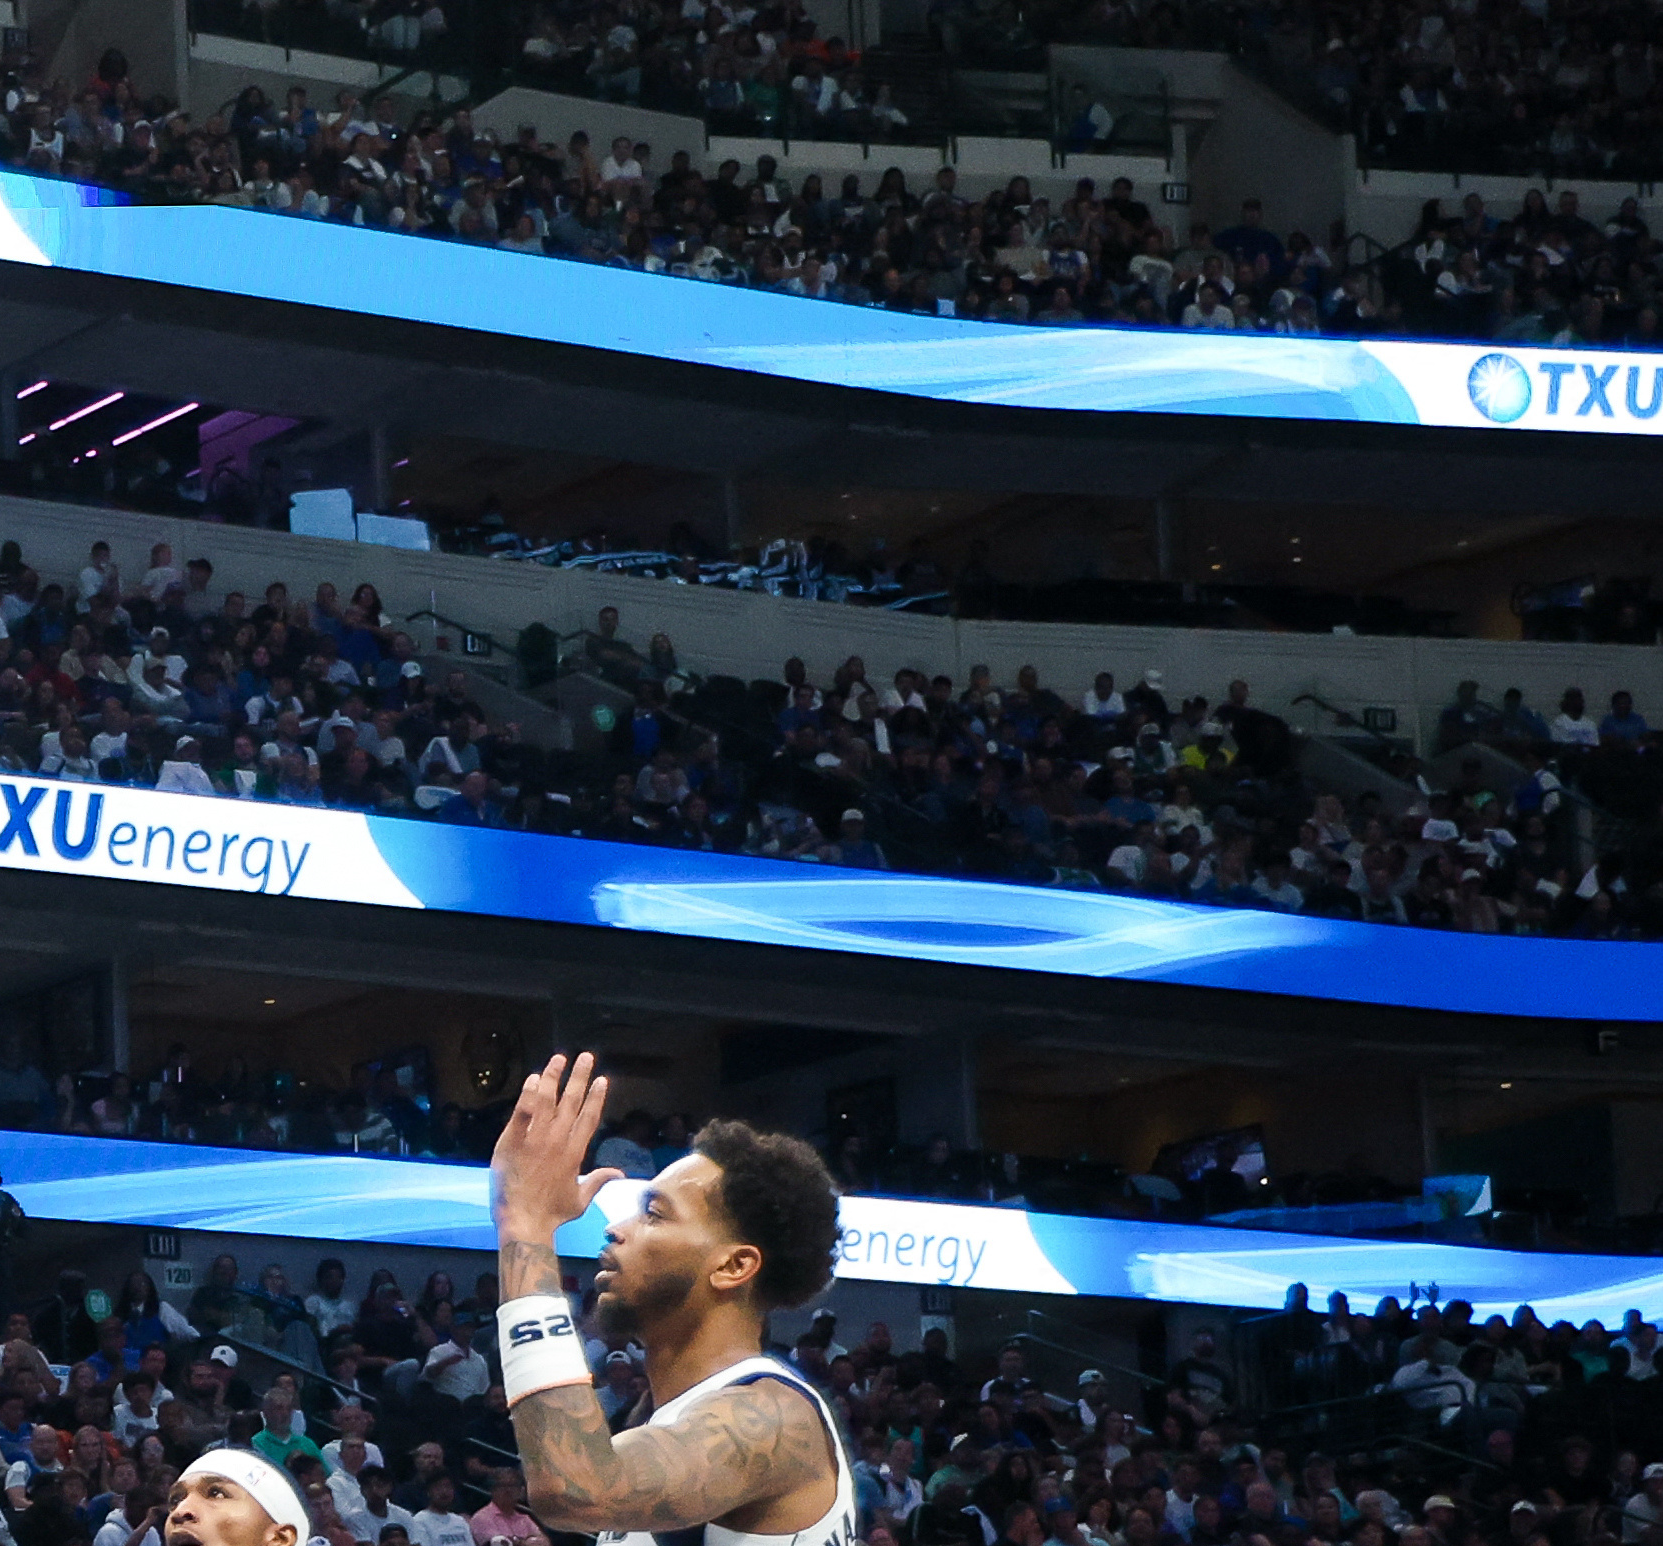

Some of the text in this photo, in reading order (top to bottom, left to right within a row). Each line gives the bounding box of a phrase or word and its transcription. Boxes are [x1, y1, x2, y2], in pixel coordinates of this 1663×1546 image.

[1538, 362, 1663, 420] TXU
[106, 813, 311, 896] energy
[840, 1226, 987, 1286] energy
